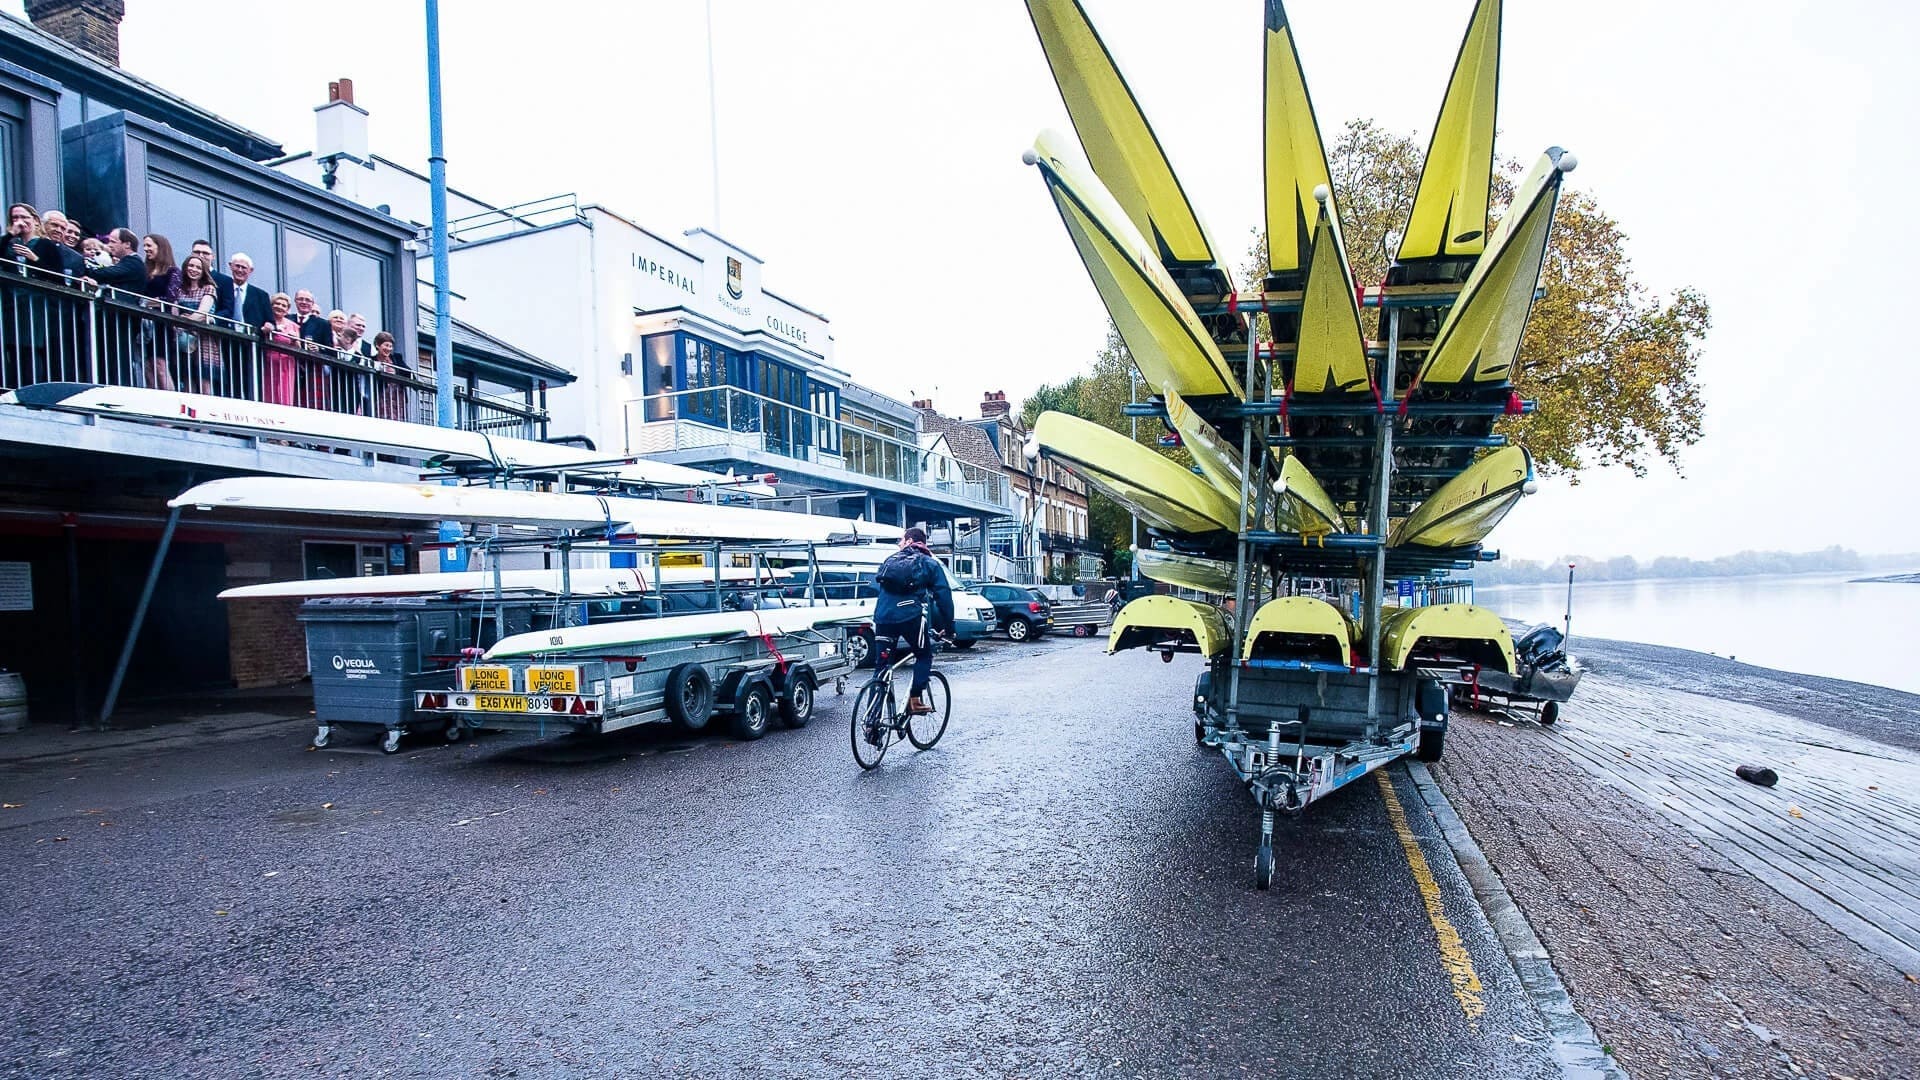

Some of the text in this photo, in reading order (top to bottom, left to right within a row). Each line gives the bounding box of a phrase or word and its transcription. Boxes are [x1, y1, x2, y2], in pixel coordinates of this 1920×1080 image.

[632, 252, 696, 295] IMPERIAL
[766, 315, 807, 344] COLLEGE
[344, 659, 375, 668] VEOLIA
[475, 670, 499, 680] LONG
[539, 671, 564, 681] LONG
[456, 697, 468, 706] GB
[480, 697, 522, 709] EX61 XVH
